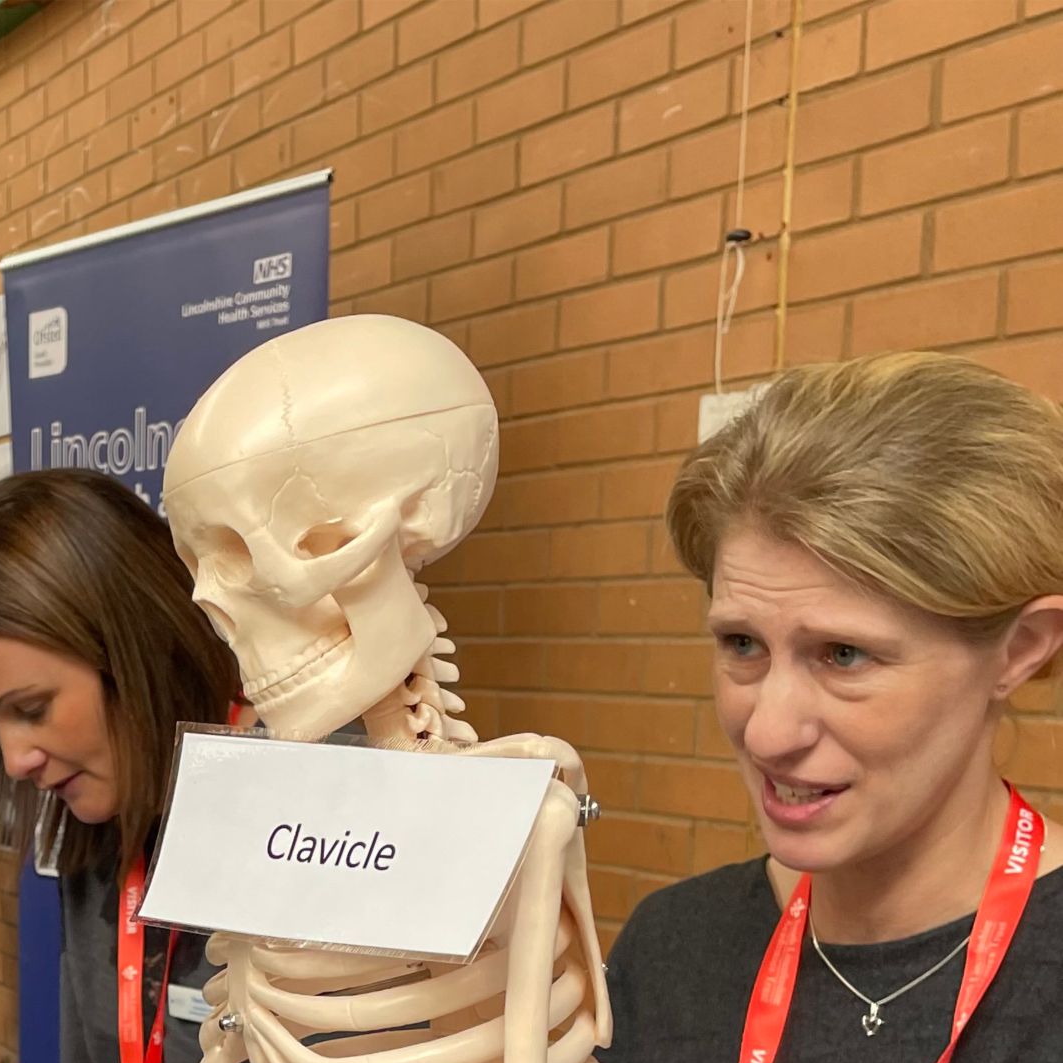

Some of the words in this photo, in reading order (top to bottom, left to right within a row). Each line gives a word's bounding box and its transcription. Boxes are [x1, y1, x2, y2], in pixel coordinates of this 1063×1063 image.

[255, 256, 288, 281] NHS
[234, 284, 291, 305] Community
[218, 307, 250, 325] Health
[31, 407, 188, 475] Lincoln
[266, 823, 397, 871] Clavicle
[1004, 808, 1035, 876] VISITOR
